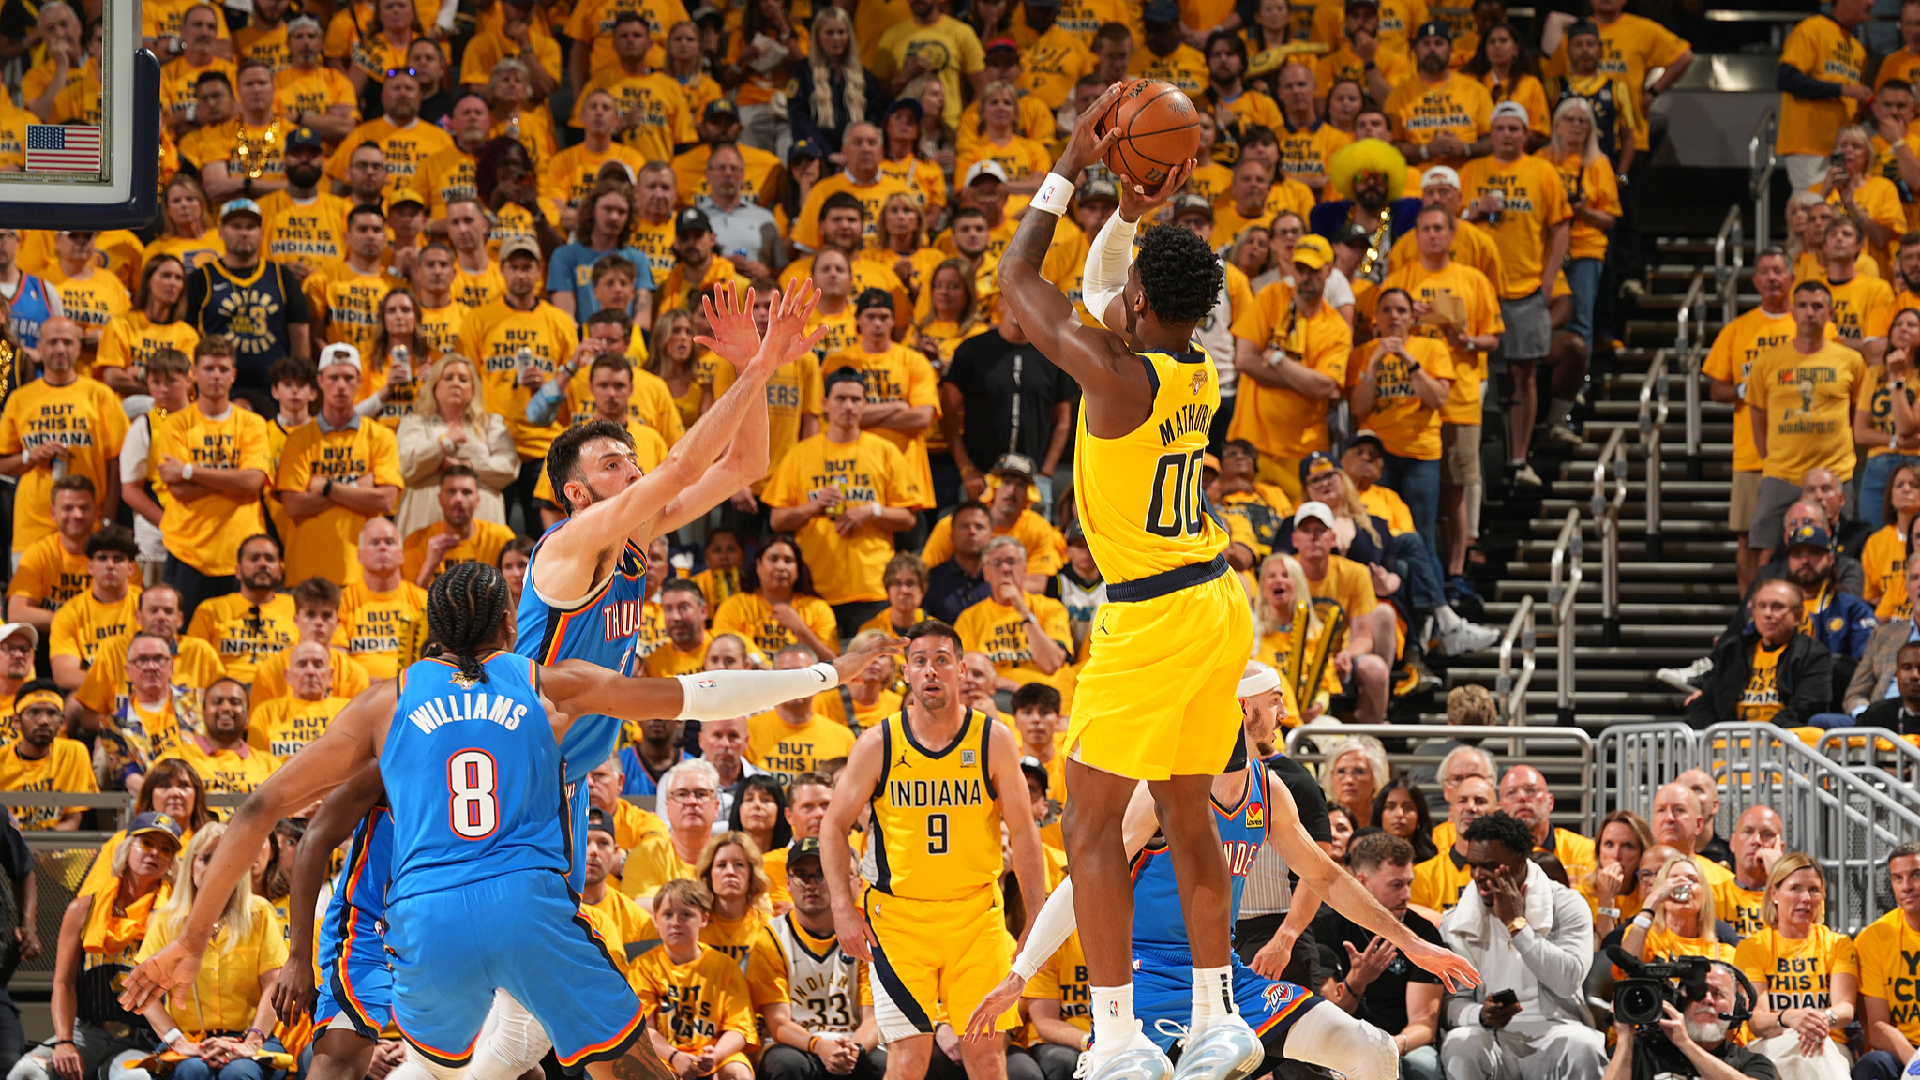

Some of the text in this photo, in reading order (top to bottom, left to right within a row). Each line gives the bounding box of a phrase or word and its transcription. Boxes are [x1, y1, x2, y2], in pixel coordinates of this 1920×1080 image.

[1407, 116, 1472, 129] INDIANA
[389, 141, 417, 149] BUT
[1488, 174, 1517, 184] BUT
[1513, 187, 1526, 196] IS
[289, 217, 317, 227] BUT
[278, 230, 331, 240] THIS IS
[271, 241, 338, 256] INDIANA
[64, 290, 94, 299] BUT
[351, 286, 378, 296] BUT
[464, 286, 488, 297] BUT
[95, 301, 108, 311] IS
[338, 296, 371, 308] THIS
[63, 309, 110, 324] DIAN
[505, 329, 537, 341] BUT
[1758, 336, 1786, 347] BUT
[536, 342, 549, 354] IS
[486, 358, 553, 373] INDNA
[41, 404, 74, 415] BUT
[29, 418, 86, 430] THIS IS
[23, 432, 93, 447] INDIANA
[203, 435, 233, 446] BUT
[191, 448, 227, 460] THIS
[324, 446, 353, 458] BUT
[312, 459, 365, 472] THIS IS
[825, 459, 857, 471] BUT
[855, 474, 869, 485] IS
[1146, 448, 1206, 539] 00
[60, 574, 91, 586] BUT
[367, 610, 399, 622] BUT
[96, 624, 126, 639] BUT
[356, 624, 395, 636] THIS
[764, 622, 787, 635] BU
[996, 622, 1026, 636] BUT
[276, 632, 291, 642] IS
[220, 640, 285, 655] INDIAN
[409, 692, 528, 735] WILLIAMS
[292, 716, 328, 729] BUT
[778, 742, 814, 755] BUT
[764, 756, 805, 772] THIS
[446, 747, 499, 841] 8
[890, 779, 982, 808] INDIANA
[927, 813, 949, 856] 9
[1777, 956, 1818, 973] BUT
[807, 992, 849, 1027] 33
